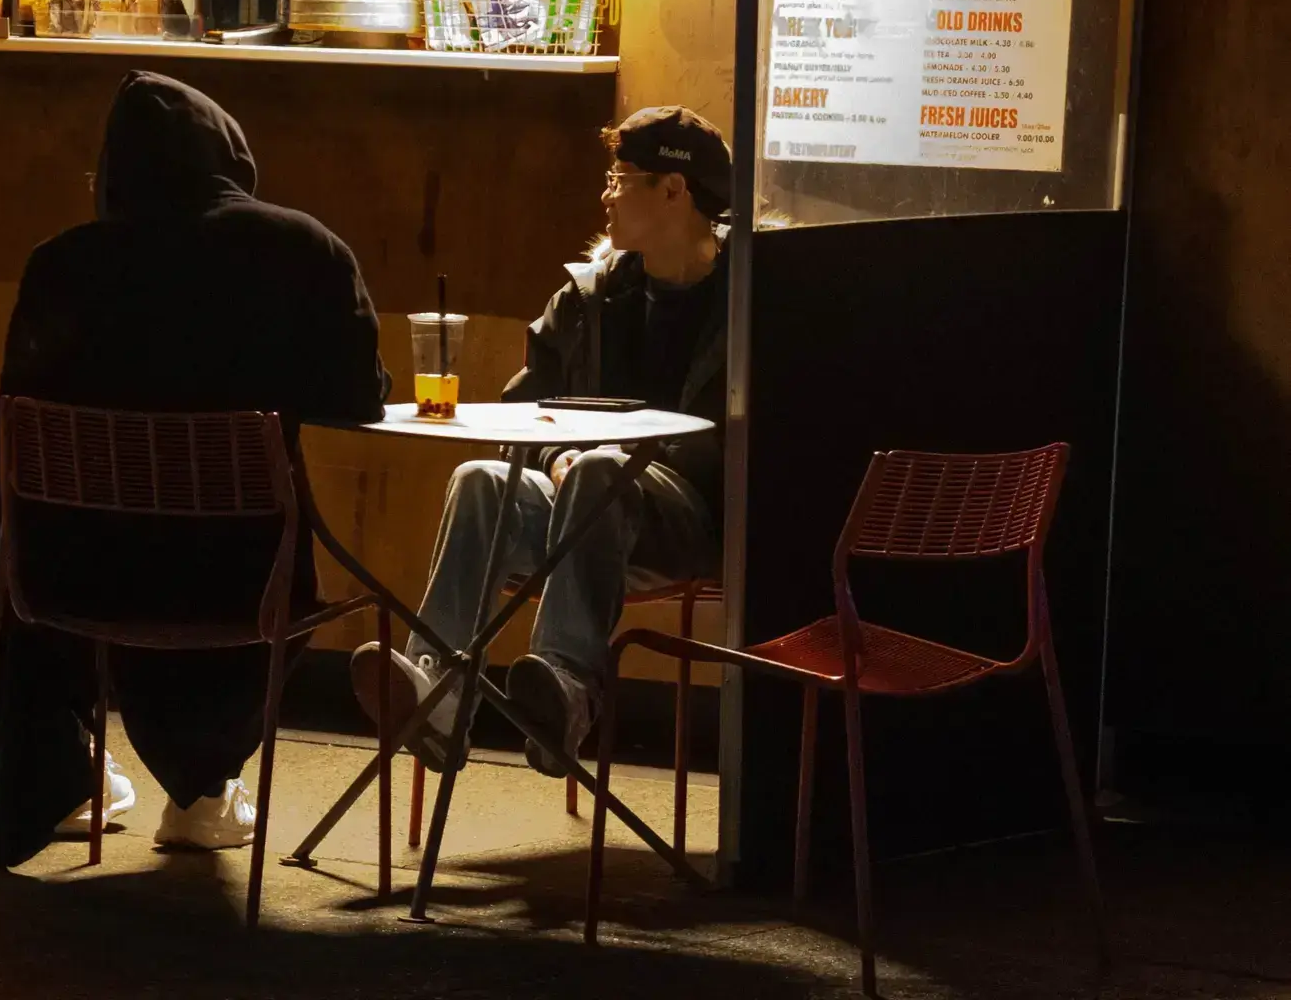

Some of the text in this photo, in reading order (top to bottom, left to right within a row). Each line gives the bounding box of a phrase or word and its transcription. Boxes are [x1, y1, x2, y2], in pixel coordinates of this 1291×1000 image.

[936, 9, 1023, 33] OLD DRINKS
[925, 37, 968, 47] OCOLATE
[969, 38, 988, 47] MILK
[937, 49, 950, 59] TEA
[923, 63, 964, 72] LEMONADE
[946, 76, 978, 86] ORANGE
[980, 77, 1002, 86] JUICE
[1008, 78, 1025, 87] 6.50
[772, 86, 830, 108] BAKERY
[921, 89, 938, 98] MUD
[959, 90, 986, 99] COFFEE
[993, 91, 1010, 100] 3.50
[920, 104, 965, 127] FRESH
[967, 107, 1019, 129] JUICES
[919, 130, 1055, 144] WATERMELON COOLER 9.00/10.00
[658, 146, 693, 161] MoMA
